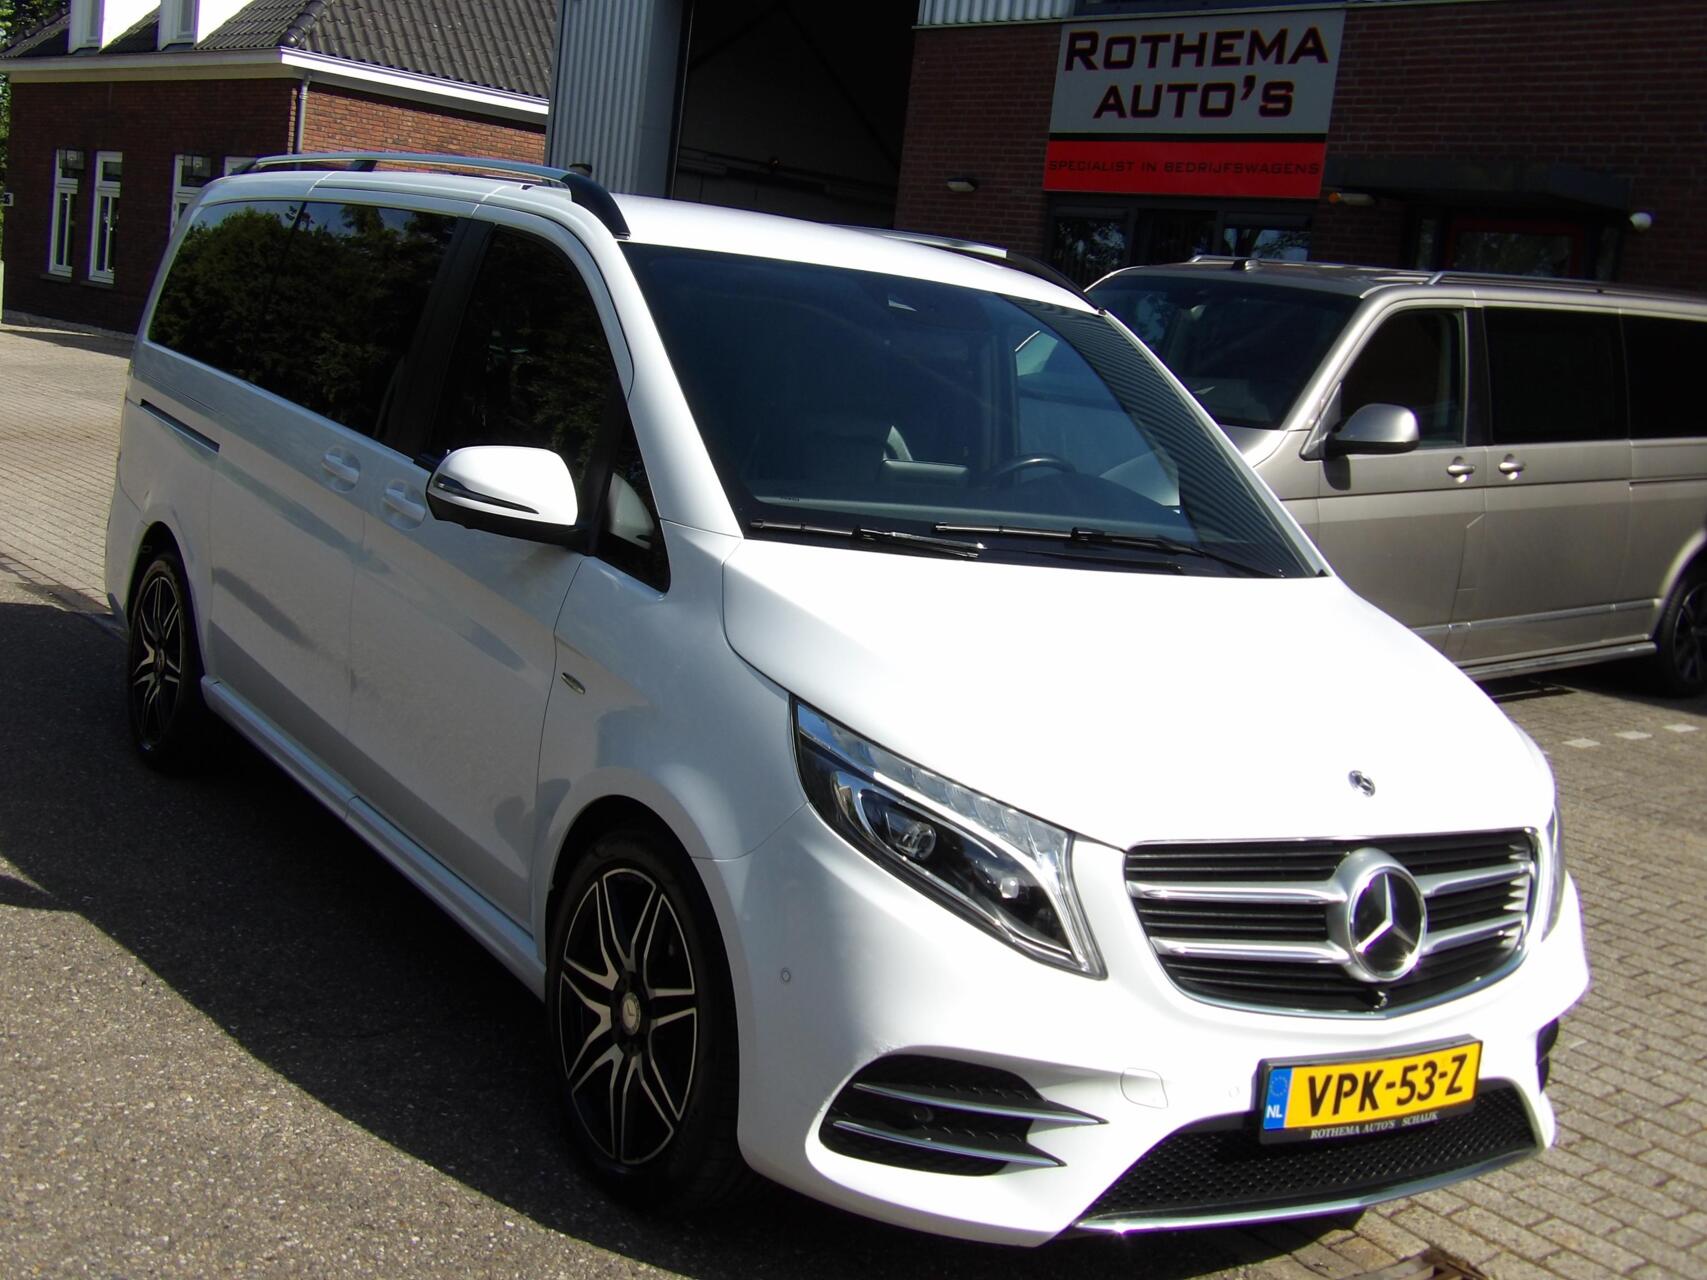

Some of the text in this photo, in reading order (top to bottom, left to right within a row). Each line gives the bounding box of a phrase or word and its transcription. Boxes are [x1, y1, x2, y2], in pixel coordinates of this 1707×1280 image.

[1064, 26, 1329, 71] ROTHEMA
[1092, 75, 1295, 119] AUTO'S
[1048, 160, 1320, 176] SPECIALIST IN BEDRIJFSWAGENS
[1308, 1053, 1468, 1118] VPK-53-Z
[1266, 1104, 1283, 1119] NL
[1310, 1125, 1361, 1140] ROTHEMA
